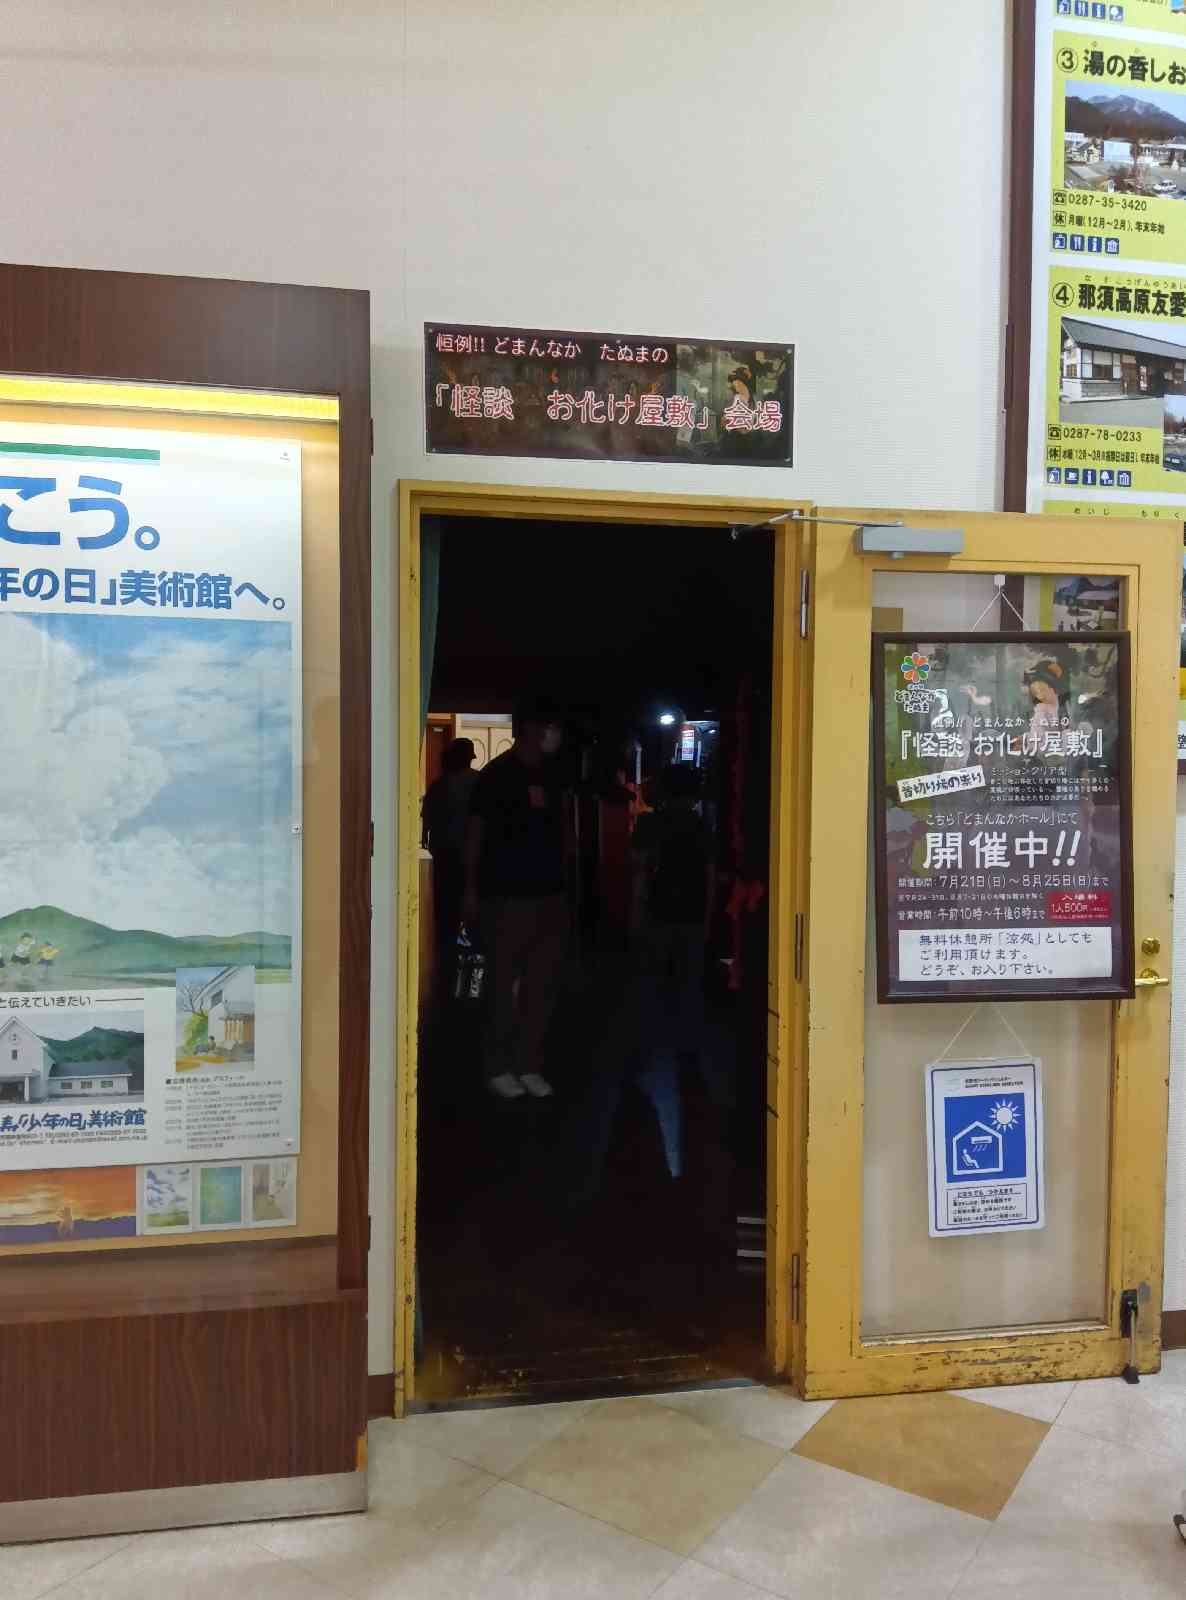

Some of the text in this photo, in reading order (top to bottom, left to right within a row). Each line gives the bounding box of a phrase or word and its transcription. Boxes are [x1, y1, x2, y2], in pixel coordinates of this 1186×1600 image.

[1068, 194, 1147, 211] 0287-35-3420
[436, 334, 668, 363] 恒例!! どまんなか たぬまの
[435, 384, 514, 420] 「怪談
[1063, 428, 1142, 441] 0287-78-0233
[922, 829, 1081, 869] 開催中!!
[919, 948, 1028, 961] ご利用頂けます。
[919, 963, 1054, 976] どうぞ、お入り下さい。
